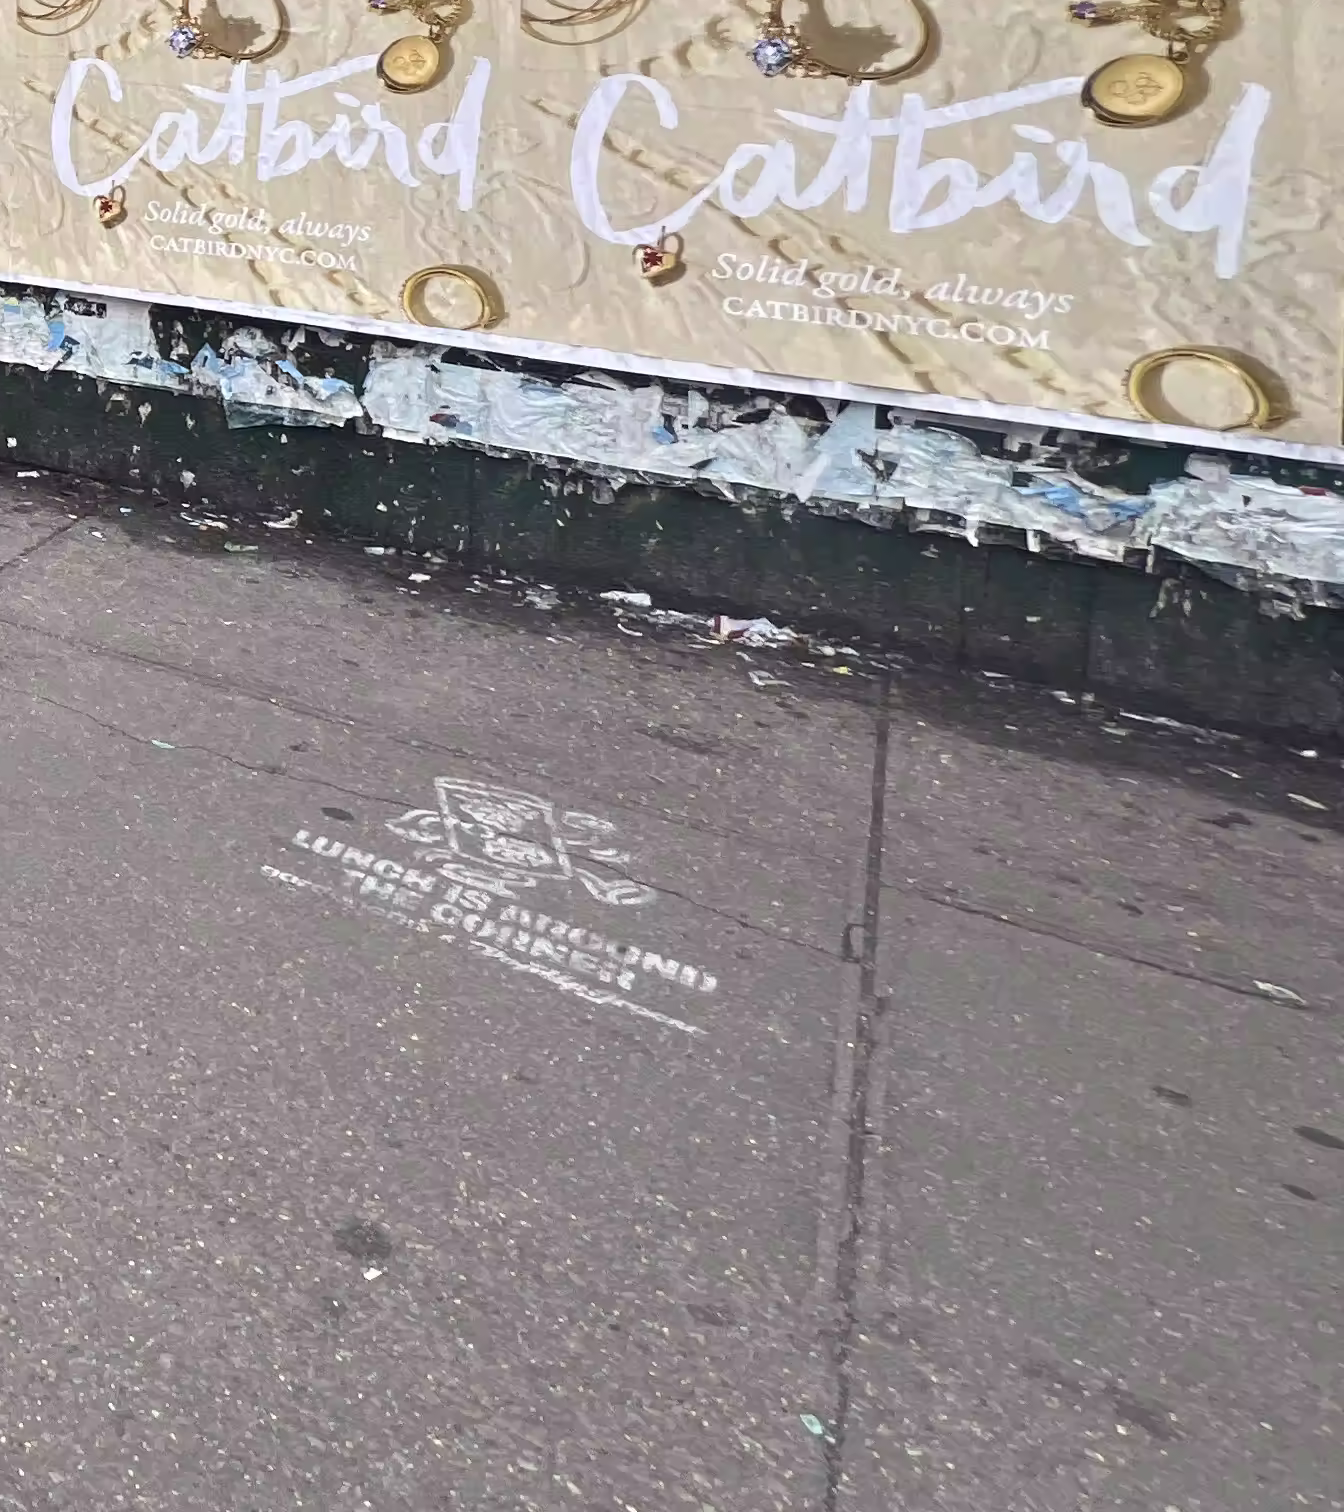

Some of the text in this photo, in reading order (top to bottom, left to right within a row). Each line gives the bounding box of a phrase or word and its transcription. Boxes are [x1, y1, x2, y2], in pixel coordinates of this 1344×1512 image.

[51, 54, 490, 211] Catbird
[570, 73, 1272, 279] Catbird
[144, 200, 371, 244] Solid gold, always
[149, 235, 356, 271] CATBIRDNYC.COM
[712, 252, 1075, 320] Solid gold, always
[722, 296, 1052, 350] CATBIRDNYC.COM
[292, 829, 437, 892] LUNCH
[443, 884, 492, 911] IS
